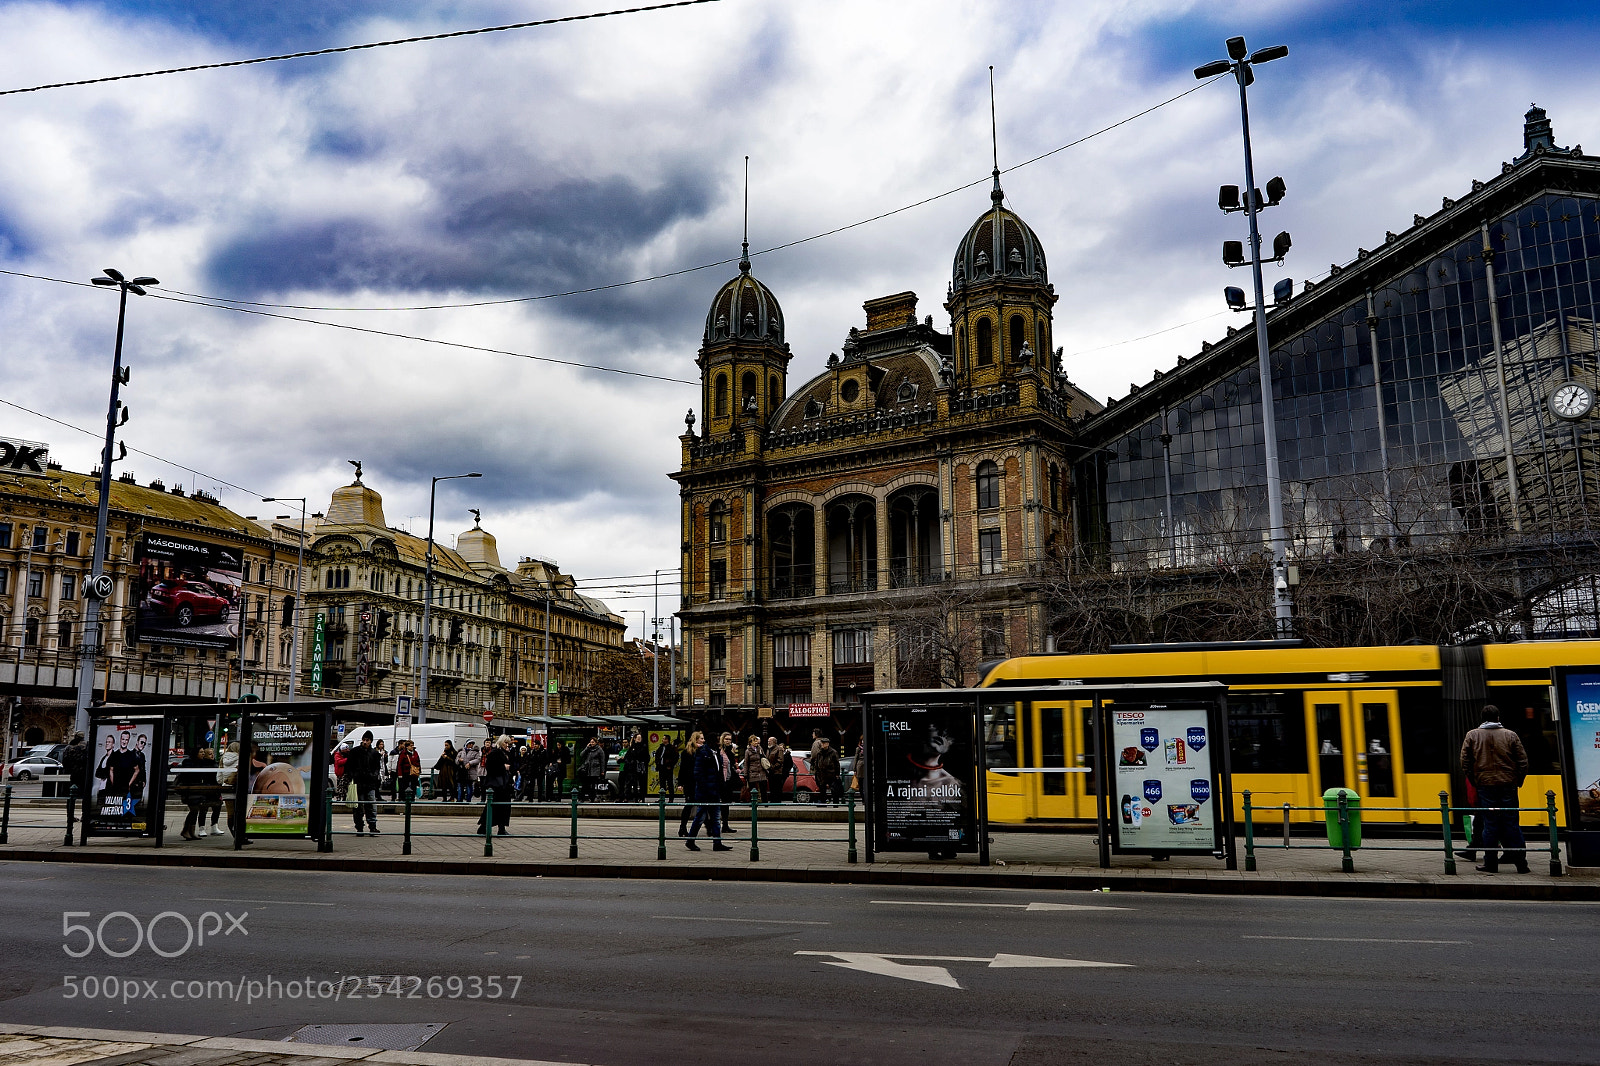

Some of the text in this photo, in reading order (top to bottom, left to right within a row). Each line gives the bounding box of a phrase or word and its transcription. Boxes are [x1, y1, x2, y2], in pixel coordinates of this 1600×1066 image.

[148, 538, 200, 553] MÁSODIKRA
[311, 613, 323, 691] SALAMAND
[269, 724, 292, 732] LEHETEK
[882, 720, 912, 732] ERKEL
[1144, 735, 1155, 743] 99
[1187, 735, 1206, 743] 1999
[886, 784, 962, 800] A rajnai sellők
[125, 798, 132, 810] 3
